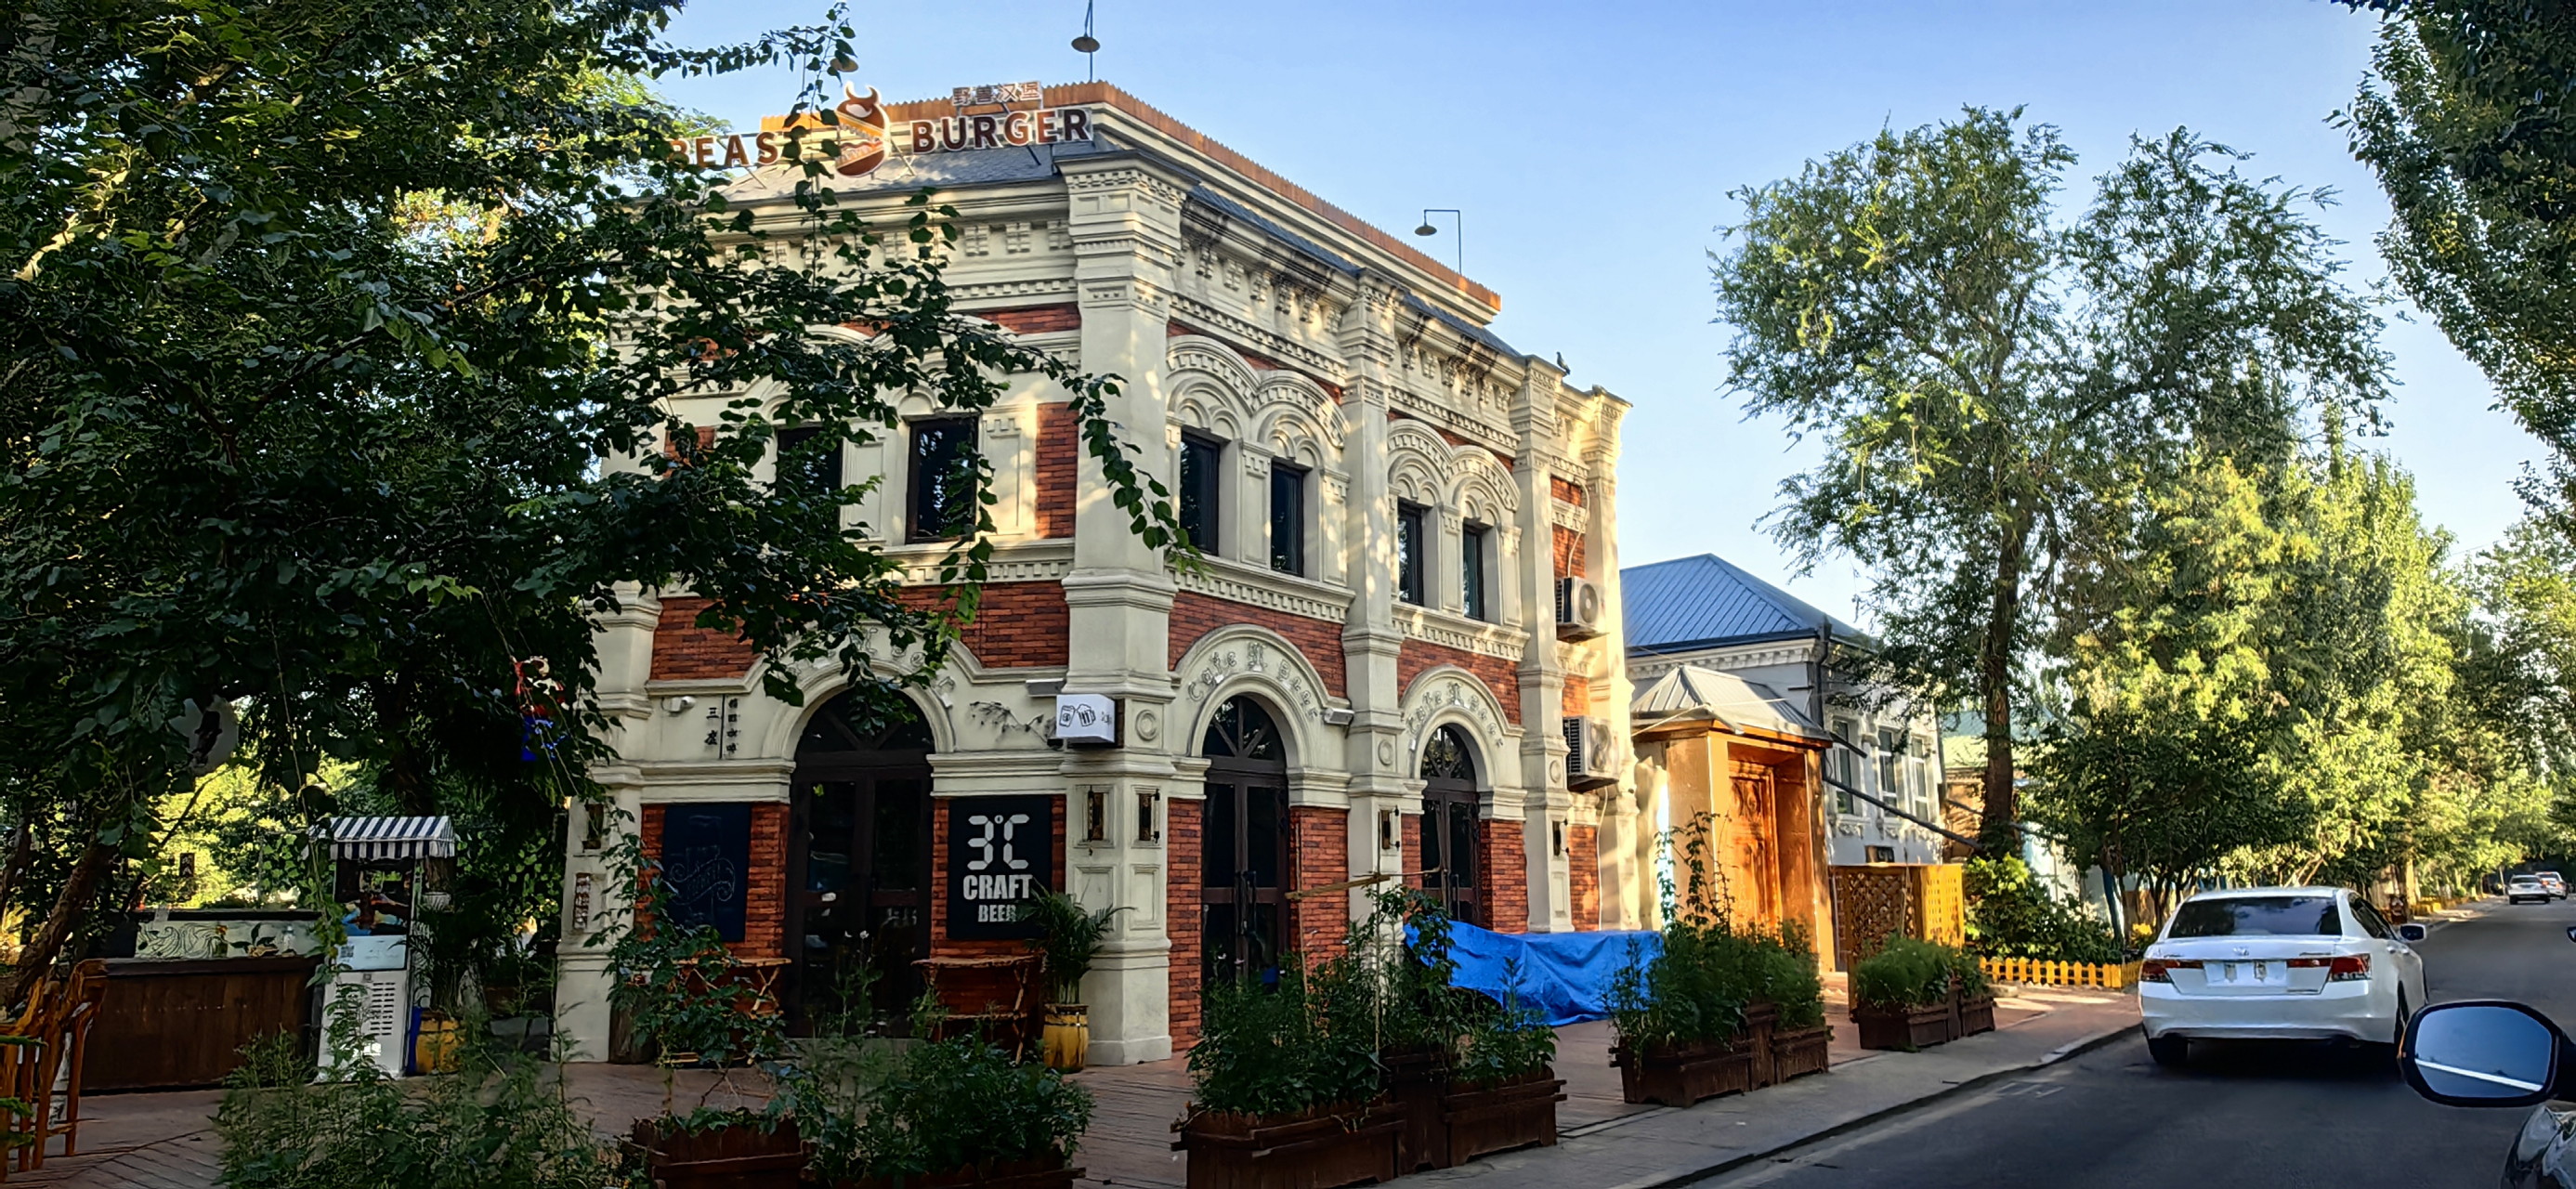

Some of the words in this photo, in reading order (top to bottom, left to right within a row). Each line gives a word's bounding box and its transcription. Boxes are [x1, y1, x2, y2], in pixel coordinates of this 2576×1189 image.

[952, 81, 1041, 106] 野兽汉堡
[666, 131, 803, 168] BEAS
[909, 108, 1091, 154] BURGER
[962, 874, 1033, 900] CRAFT
[977, 904, 1016, 922] BEER
